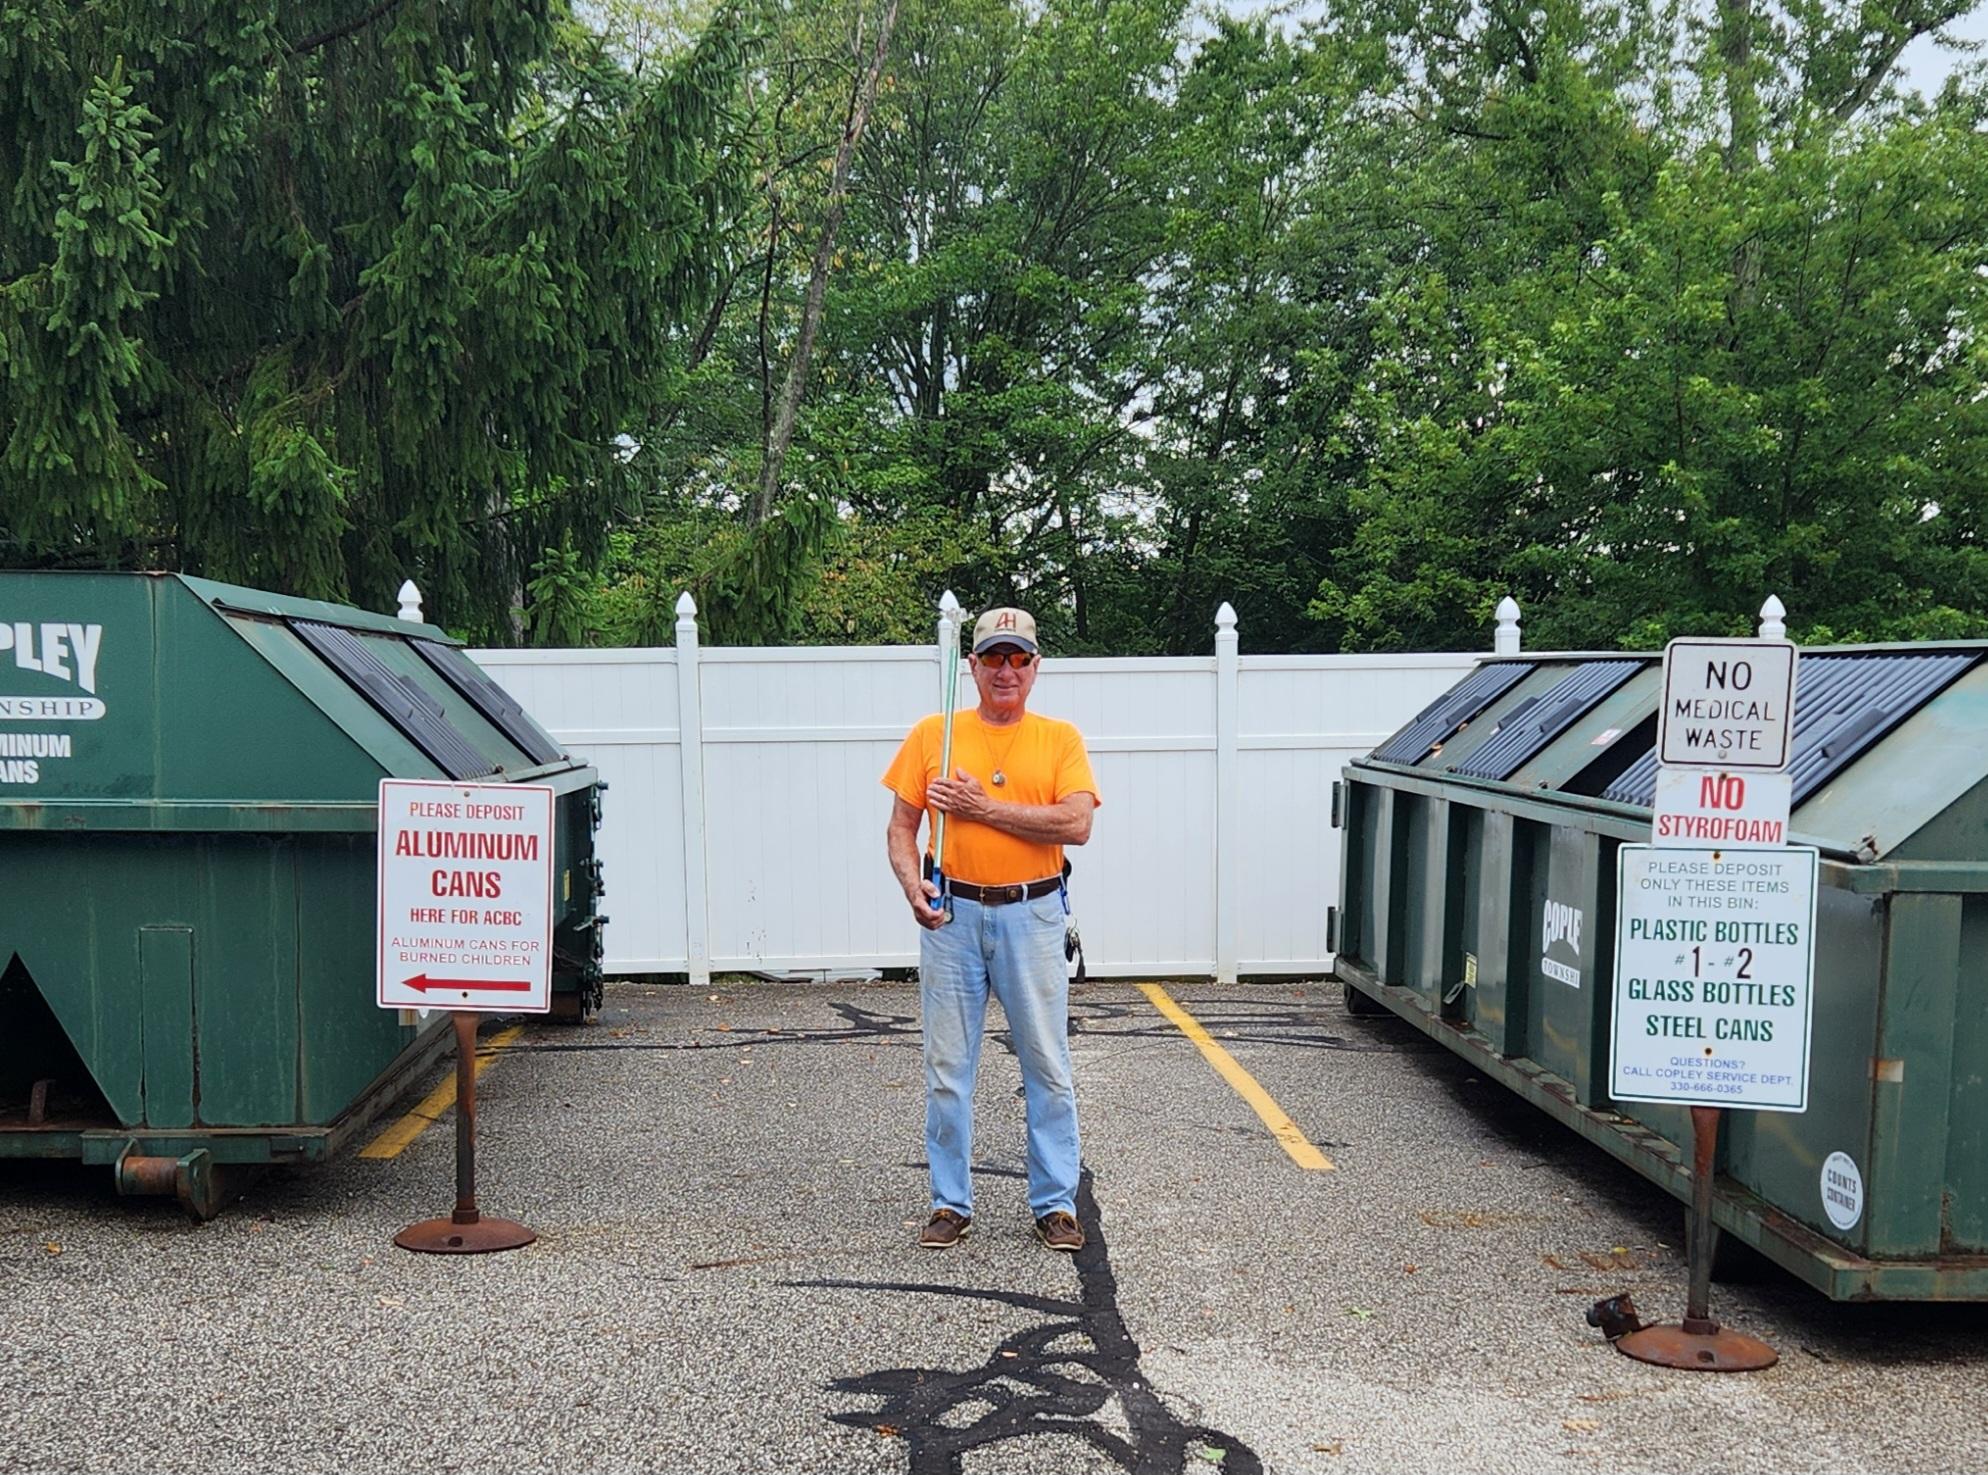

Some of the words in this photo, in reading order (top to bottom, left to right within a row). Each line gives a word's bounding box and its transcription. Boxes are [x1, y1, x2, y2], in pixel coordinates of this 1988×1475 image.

[1706, 661, 1752, 690] NO
[1675, 699, 1776, 721] MEDICAL
[1686, 728, 1762, 750] WASTE
[1699, 775, 1745, 810] NO
[410, 802, 460, 818] PLEASE
[467, 804, 525, 820] DEPOSIT
[1659, 814, 1782, 843] STYROFOAM
[396, 830, 538, 860] ALUMINUM
[1648, 862, 1709, 875] PLEASE
[1715, 863, 1783, 876] DEPOSIT
[432, 870, 501, 898] CANS
[1640, 878, 1681, 891] ONLY
[1686, 880, 1736, 892] THESE
[1742, 881, 1790, 893] ITEMS
[1668, 896, 1682, 907] IN
[1688, 896, 1722, 909] THIS
[1727, 898, 1759, 909] BIN:
[410, 908, 445, 923] HERE
[451, 909, 478, 924] FOR
[484, 911, 522, 926] ACBC
[1630, 918, 1707, 943] PLASTIC
[1715, 921, 1799, 945] BOTTLES
[391, 937, 465, 949] ALUMINUM
[469, 939, 507, 950] CANS
[512, 941, 540, 951] FOR
[400, 952, 457, 964] BURNED
[462, 954, 531, 965] CHILDREN
[1628, 978, 1694, 1002] GLASS
[1703, 982, 1796, 1007] BOTTLES
[1646, 1014, 1706, 1038] STEEL
[1716, 1018, 1773, 1042] CANS
[1670, 1057, 1746, 1069] QUESTIONS?
[1623, 1066, 1652, 1077] CALL
[1656, 1068, 1701, 1080] COPLEY
[1707, 1071, 1757, 1084] SERVICE
[1761, 1075, 1793, 1086] DEPT.
[1670, 1081, 1743, 1094] 330-666-0365
